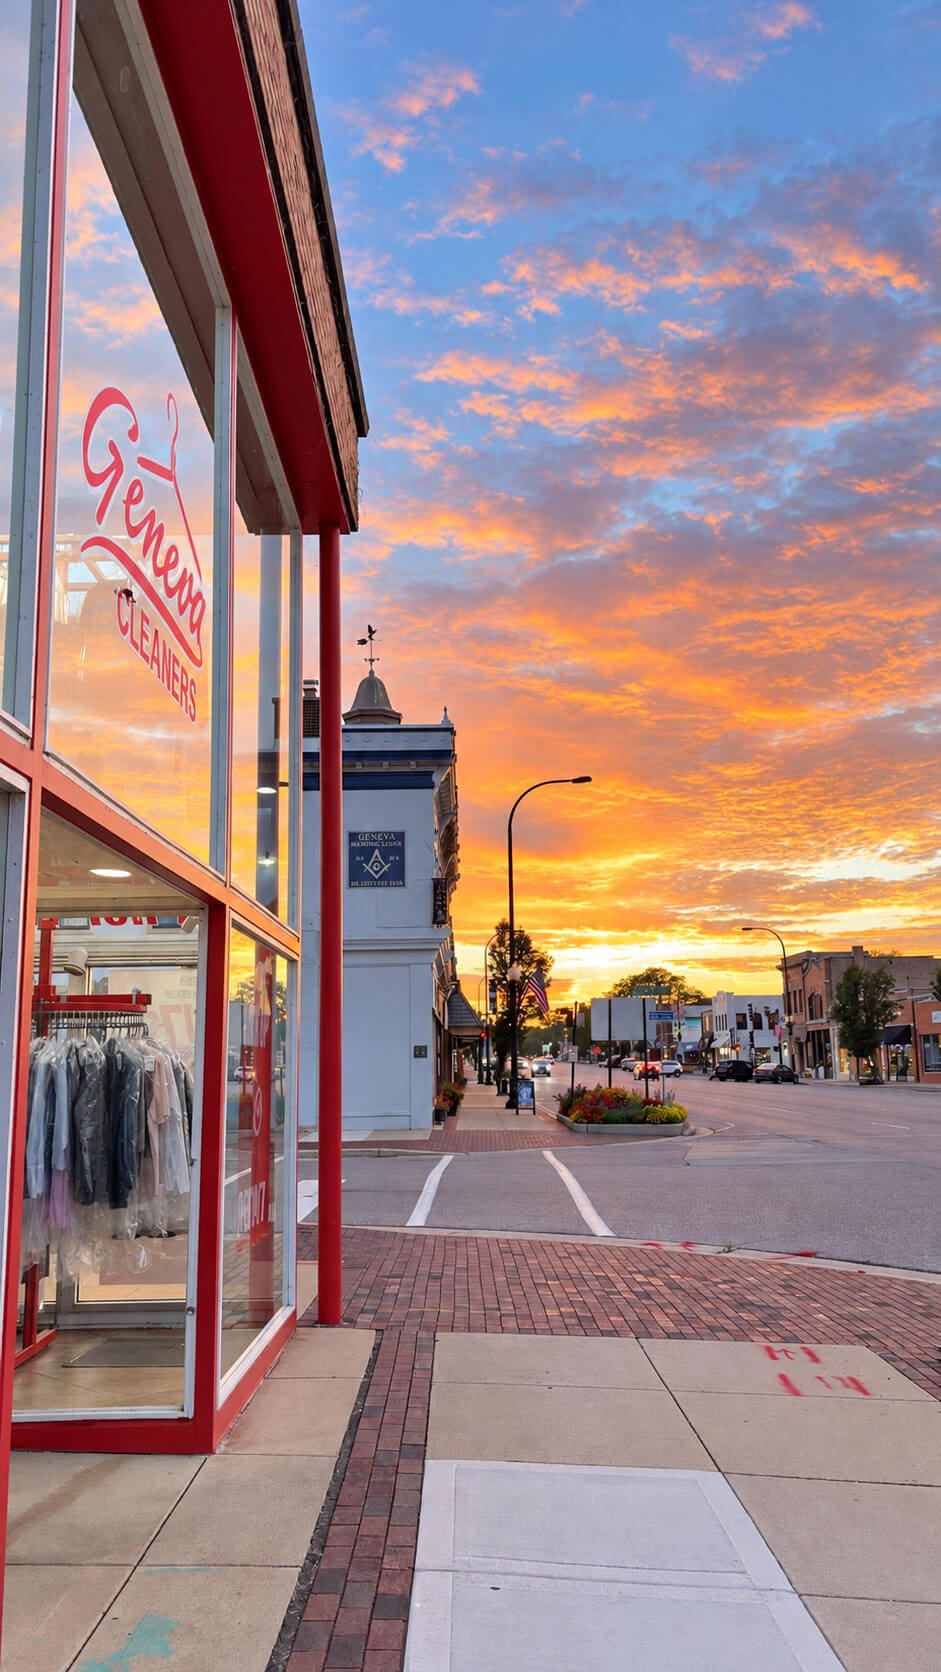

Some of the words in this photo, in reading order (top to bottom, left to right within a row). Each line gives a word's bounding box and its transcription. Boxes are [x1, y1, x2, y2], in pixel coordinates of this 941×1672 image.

[82, 386, 206, 645] Geneva
[116, 588, 197, 722] CLEANERS
[358, 832, 396, 841] GENEVA
